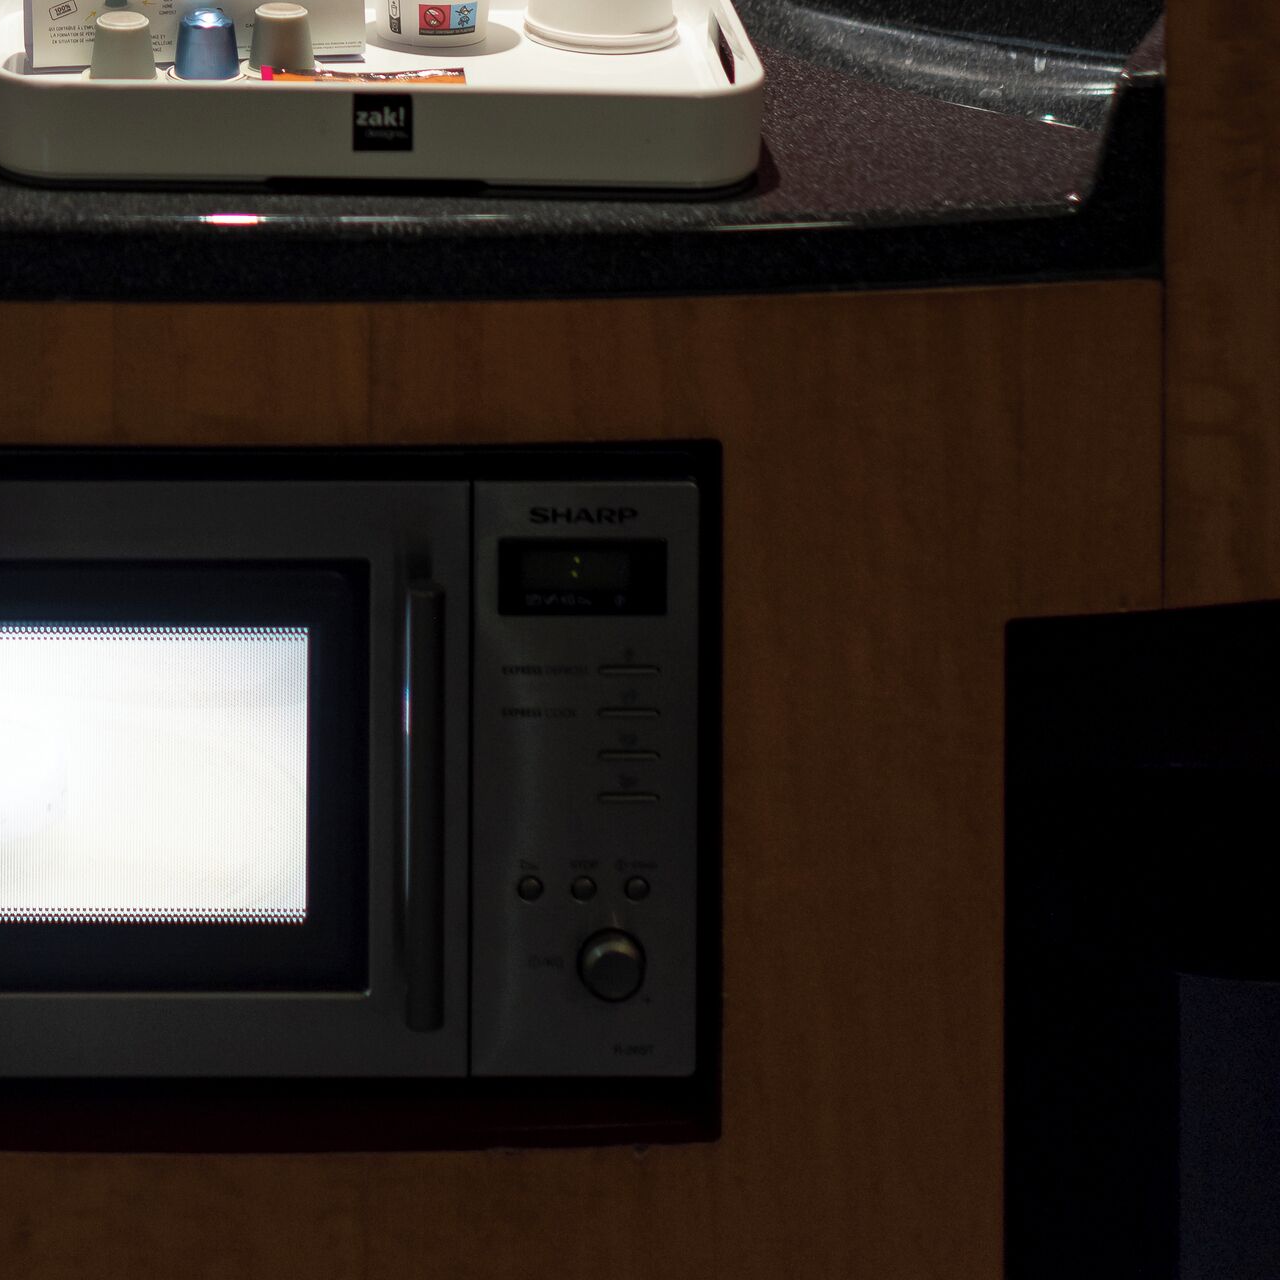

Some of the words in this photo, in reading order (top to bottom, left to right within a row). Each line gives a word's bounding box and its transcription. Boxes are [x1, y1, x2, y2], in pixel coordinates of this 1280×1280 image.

[54, 3, 71, 14] 100%
[356, 106, 405, 127] zak!
[529, 507, 638, 524] SHARP
